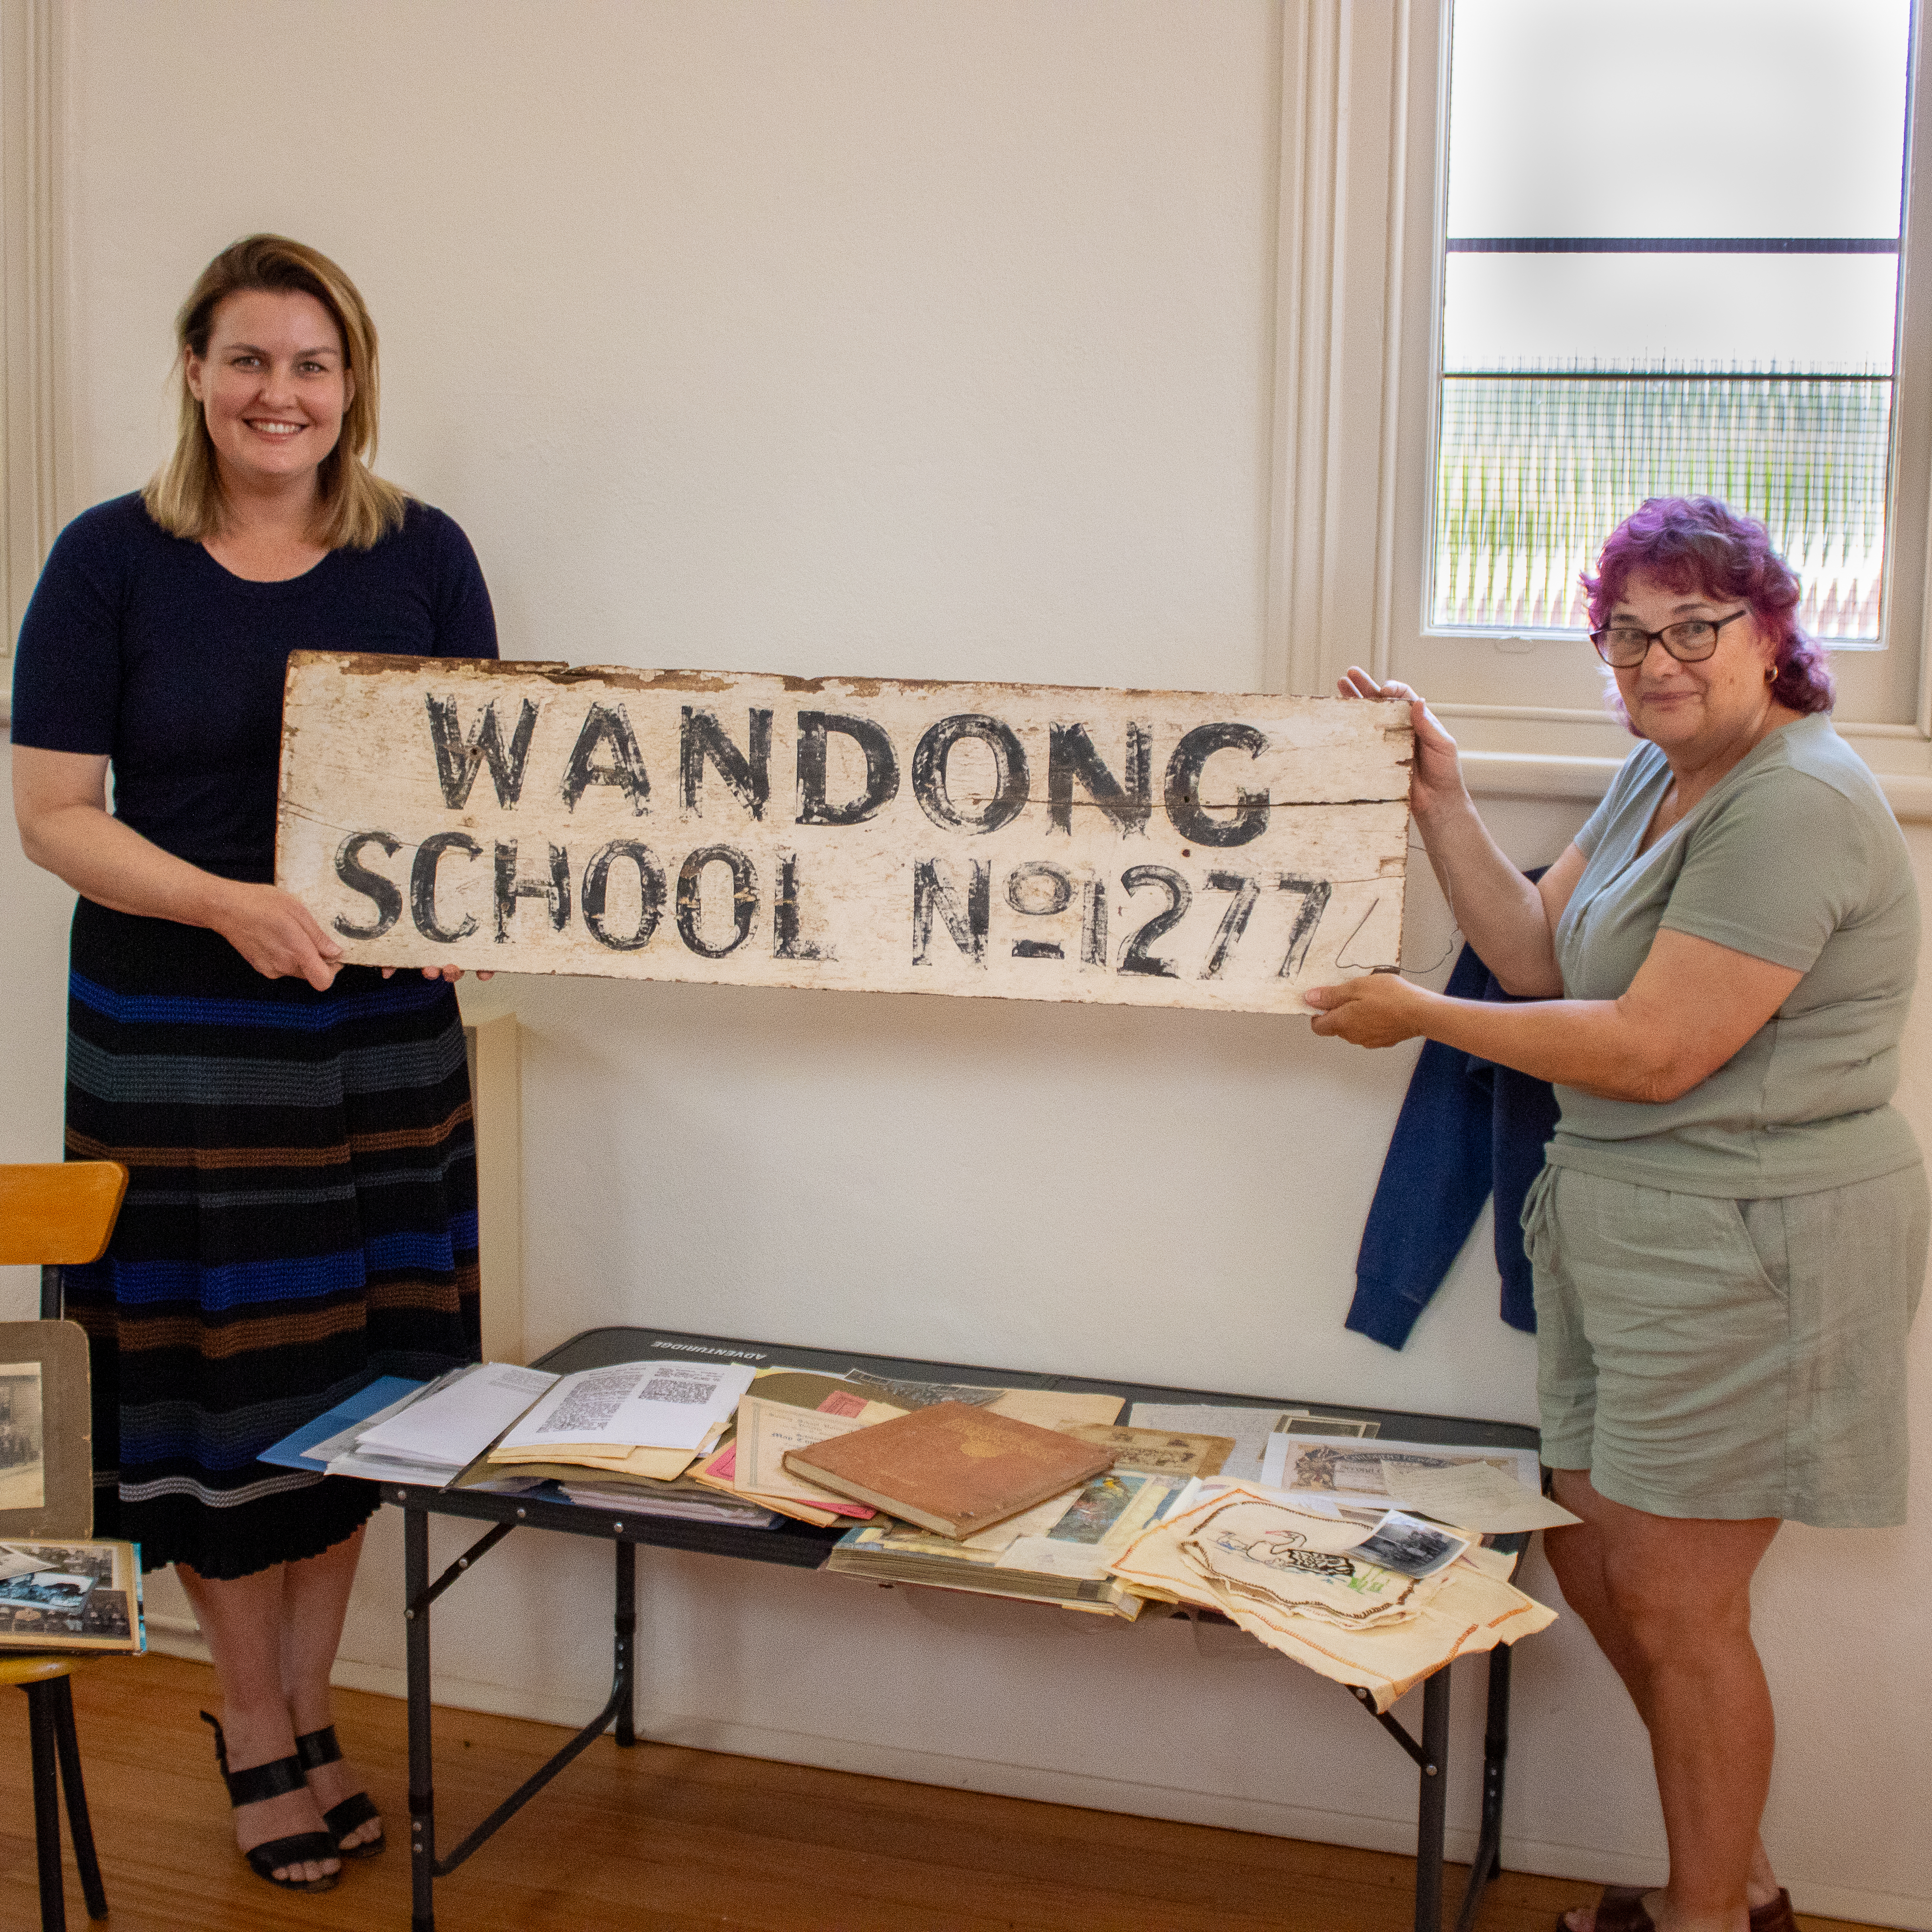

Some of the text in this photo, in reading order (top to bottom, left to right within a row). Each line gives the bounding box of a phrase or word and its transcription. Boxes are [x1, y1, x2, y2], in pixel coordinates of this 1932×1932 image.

[425, 692, 1271, 848] WANDONG
[333, 831, 839, 963] SCHOOL
[652, 1341, 767, 1360] ADVENTURIDGE
